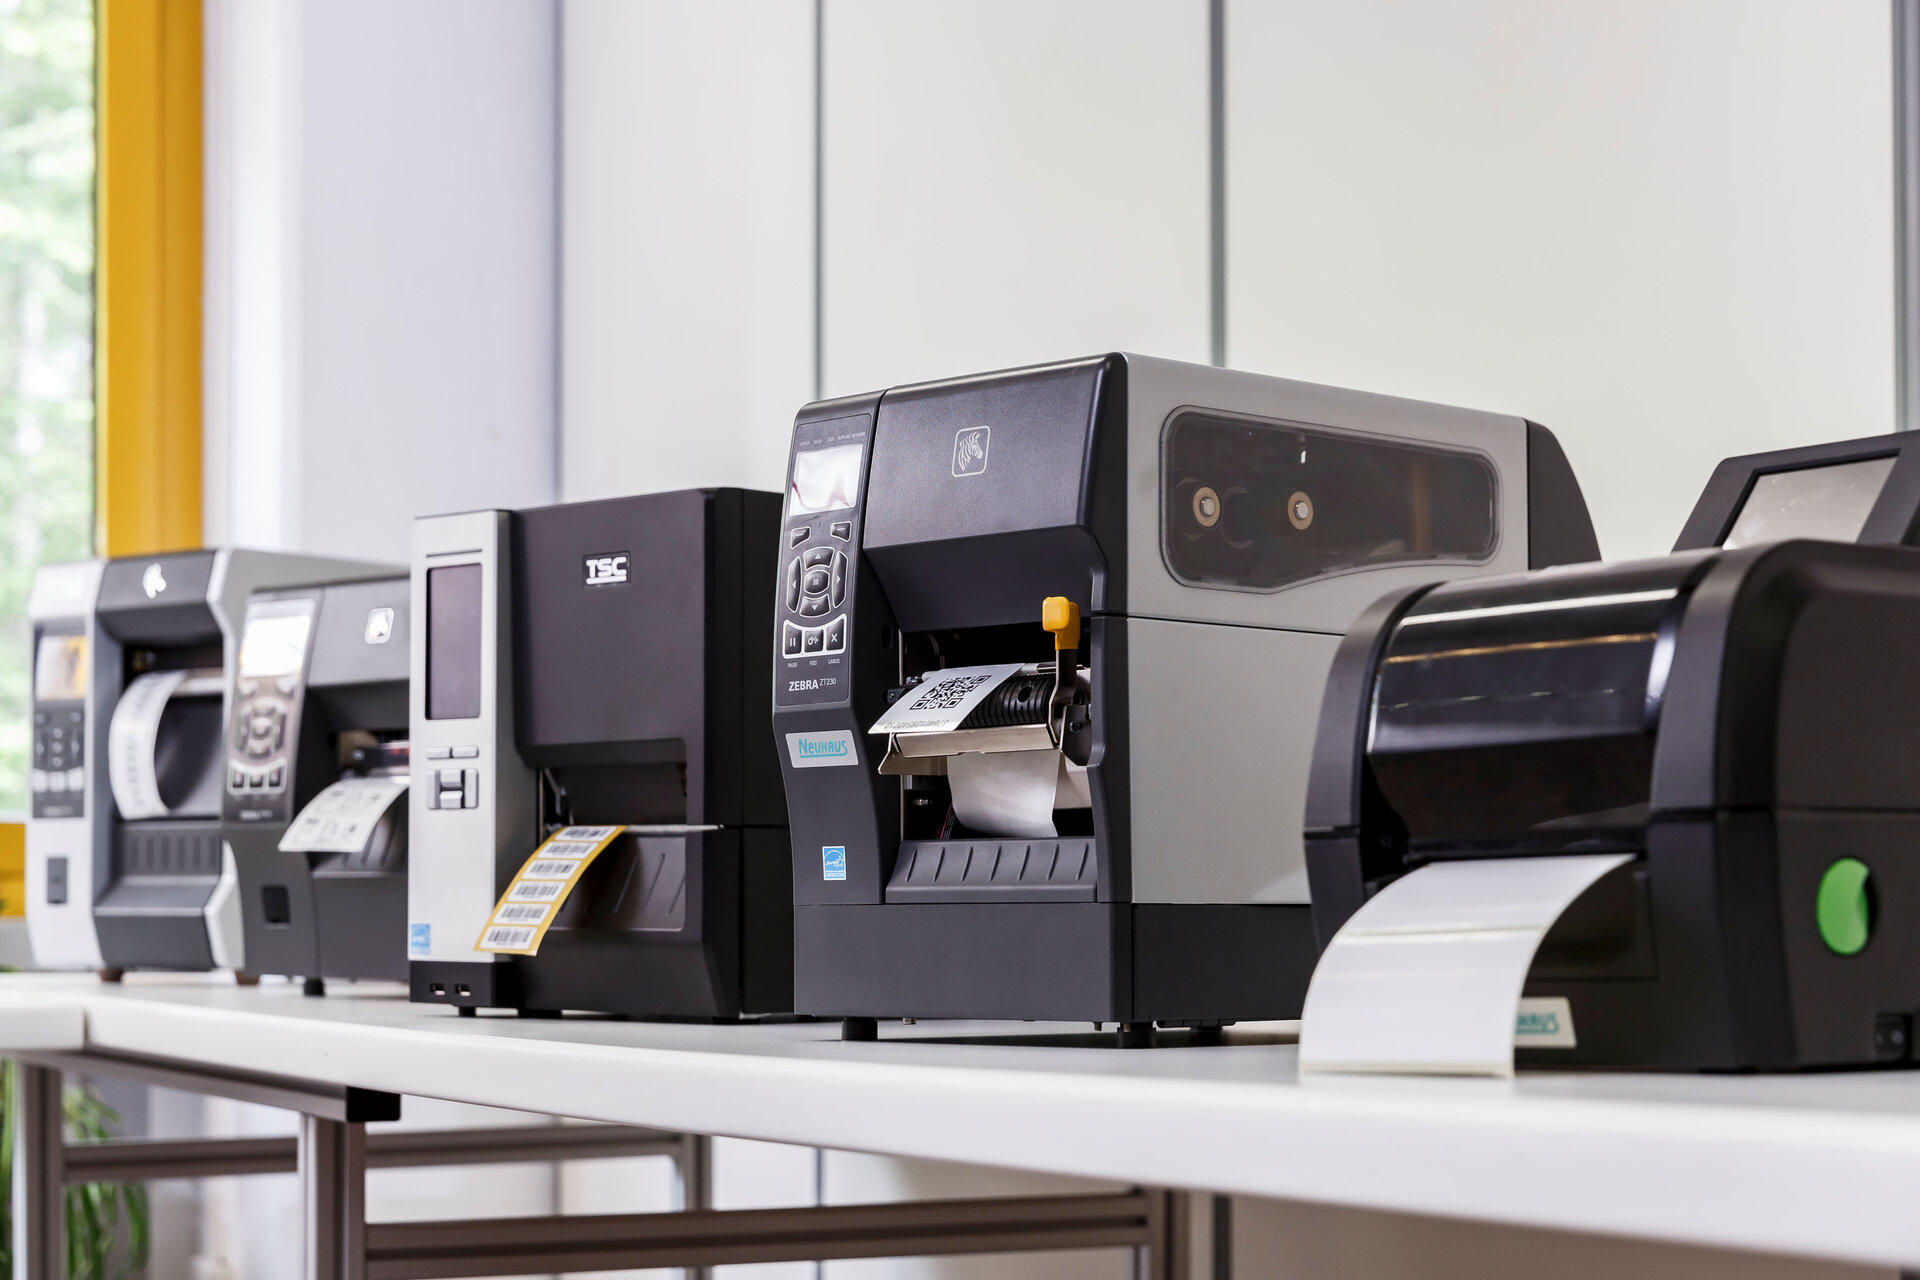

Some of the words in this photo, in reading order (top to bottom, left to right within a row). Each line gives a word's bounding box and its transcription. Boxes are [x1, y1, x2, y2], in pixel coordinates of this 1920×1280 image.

[586, 556, 627, 582] TSC
[788, 679, 819, 692] ZEBRA
[819, 677, 837, 686] ZT230
